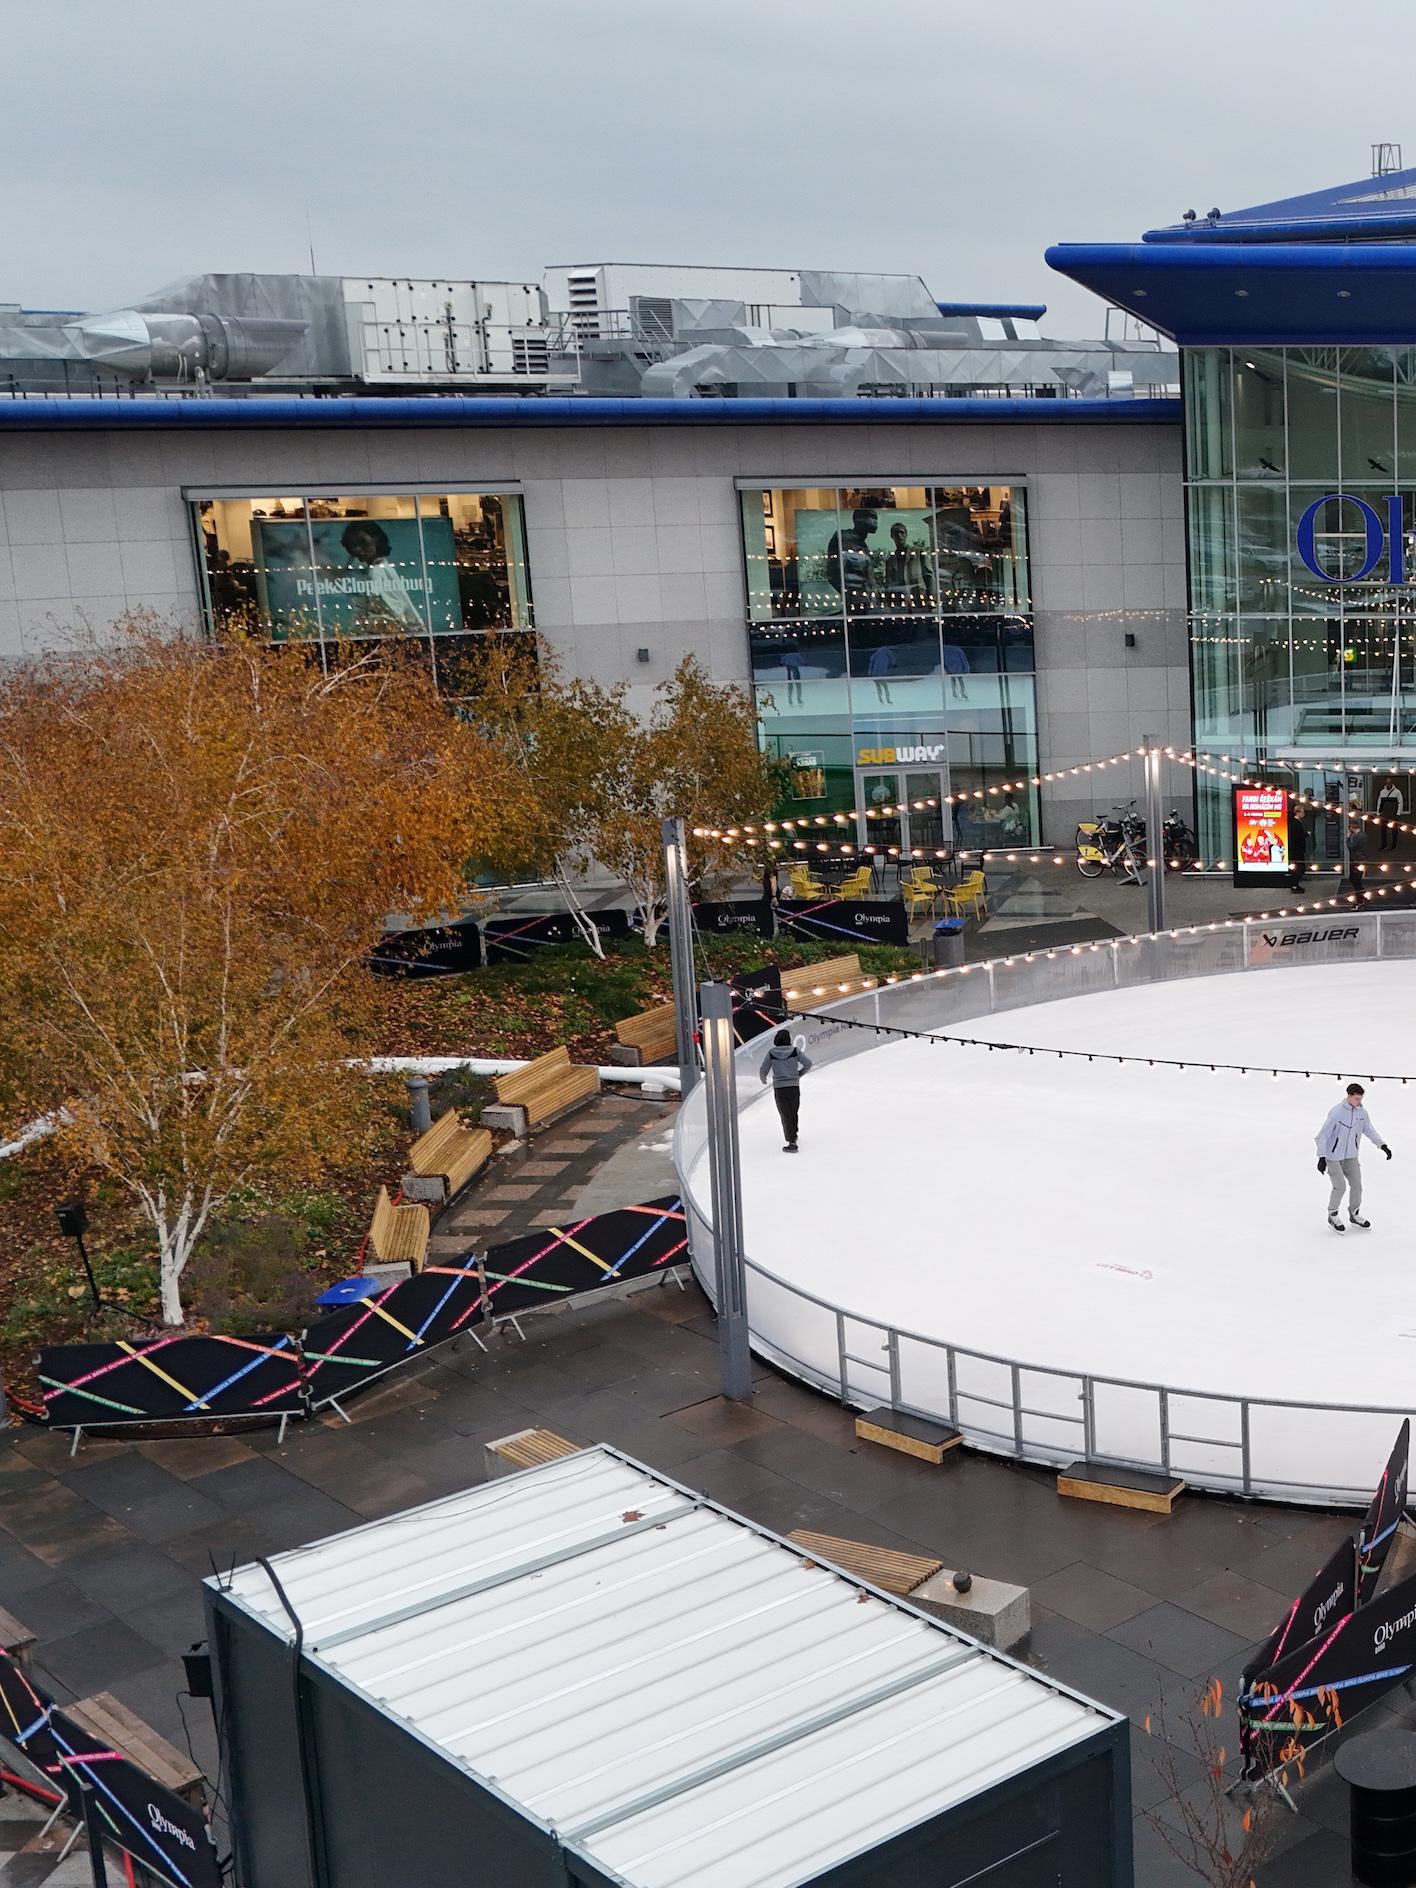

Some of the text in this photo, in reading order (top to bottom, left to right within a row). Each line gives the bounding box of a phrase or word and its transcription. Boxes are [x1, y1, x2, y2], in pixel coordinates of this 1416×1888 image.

[857, 745, 944, 765] SUBWAY
[855, 913, 891, 923] Olympia
[1280, 927, 1360, 946] BAUER
[1314, 1582, 1344, 1626] Olympia
[147, 1803, 196, 1851] Olympia
